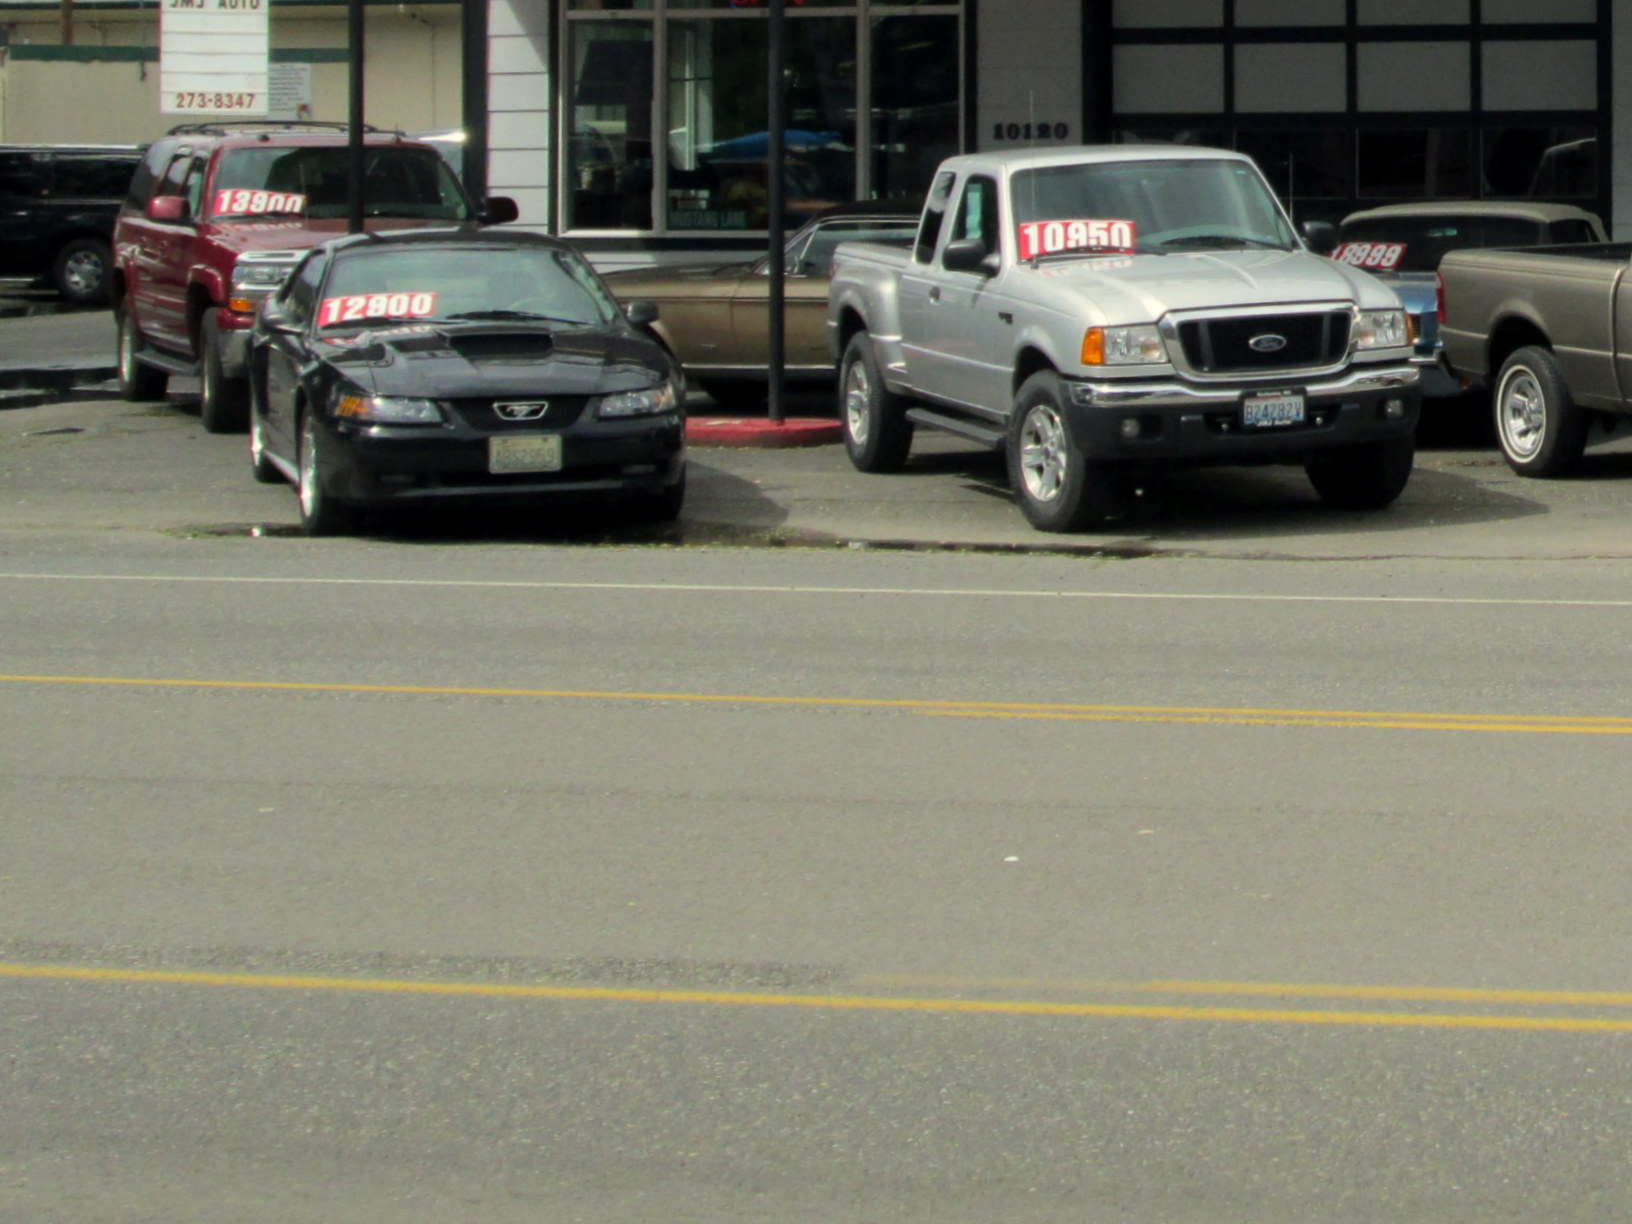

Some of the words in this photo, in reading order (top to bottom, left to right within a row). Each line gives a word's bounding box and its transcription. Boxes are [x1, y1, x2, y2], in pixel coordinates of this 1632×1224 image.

[175, 92, 257, 109] 273-8347
[992, 121, 1070, 141] 10120
[218, 189, 305, 214] 13900
[1022, 222, 1132, 256] 10950
[325, 293, 434, 323] 12900
